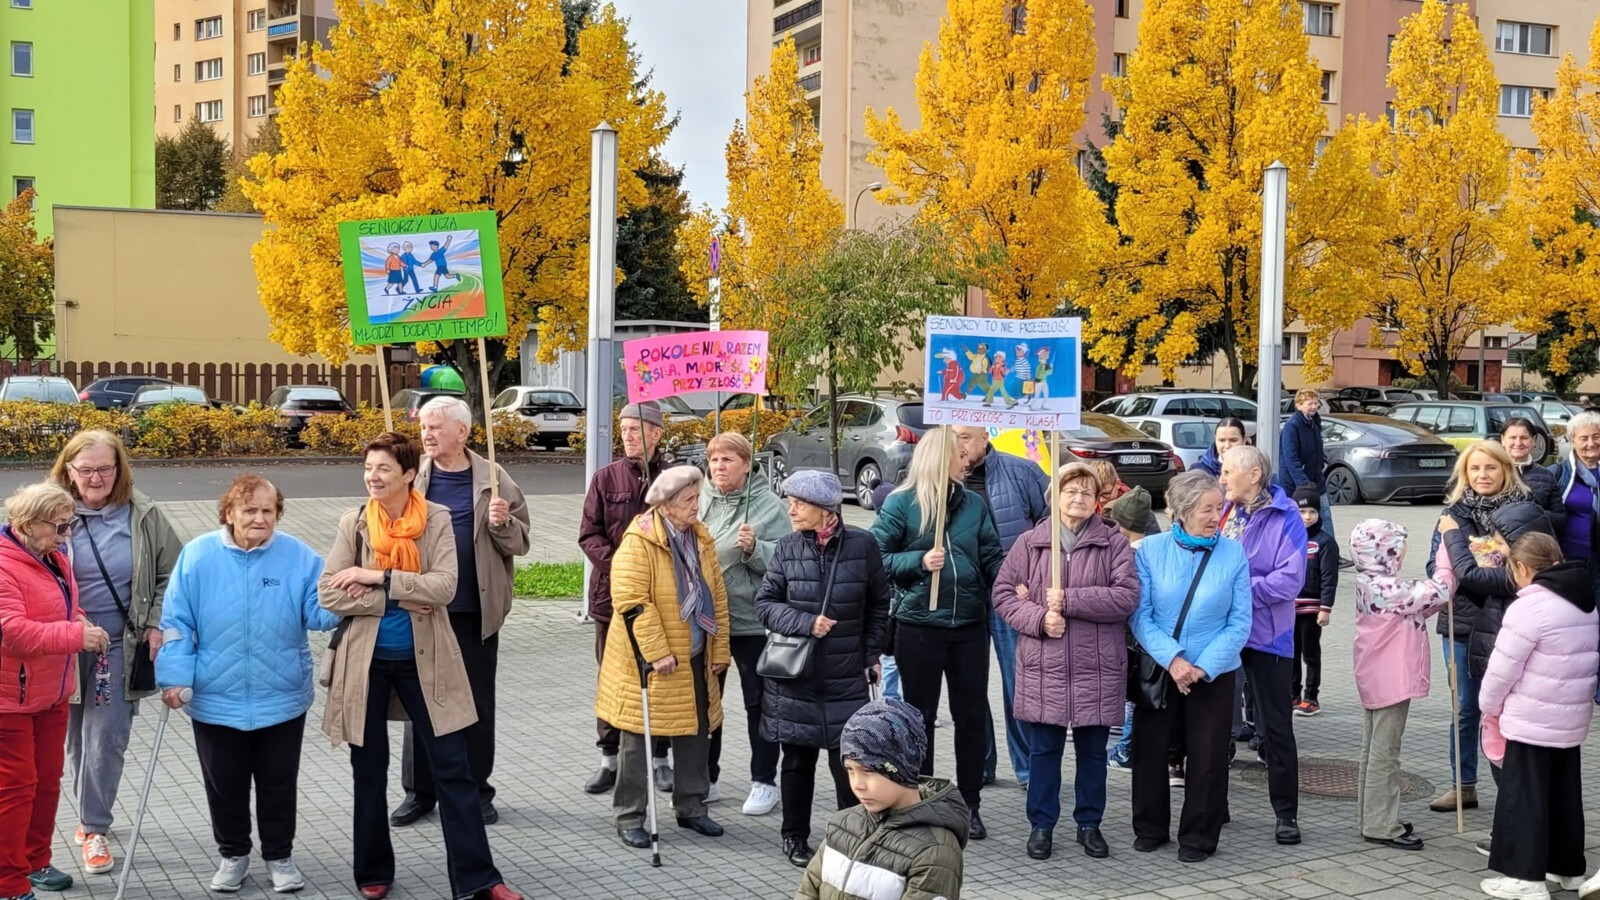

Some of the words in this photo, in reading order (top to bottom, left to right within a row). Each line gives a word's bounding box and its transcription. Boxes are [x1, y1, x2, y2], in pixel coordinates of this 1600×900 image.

[359, 219, 423, 235] SENIORZY
[402, 294, 453, 311] ŻYCIA
[354, 326, 394, 342] MŁODZI
[402, 323, 444, 339] DODAJĄ
[452, 311, 498, 335] TEMPO!
[929, 317, 980, 332] SENIORZY
[985, 320, 998, 332] TO
[1000, 321, 1015, 333] NIE
[726, 341, 762, 356] RAZEM
[672, 374, 741, 392] PRZYSZŁOŚĆ
[928, 409, 943, 421] TO
[1009, 414, 1017, 425] Z
[1025, 412, 1060, 428] KLASĄ!
